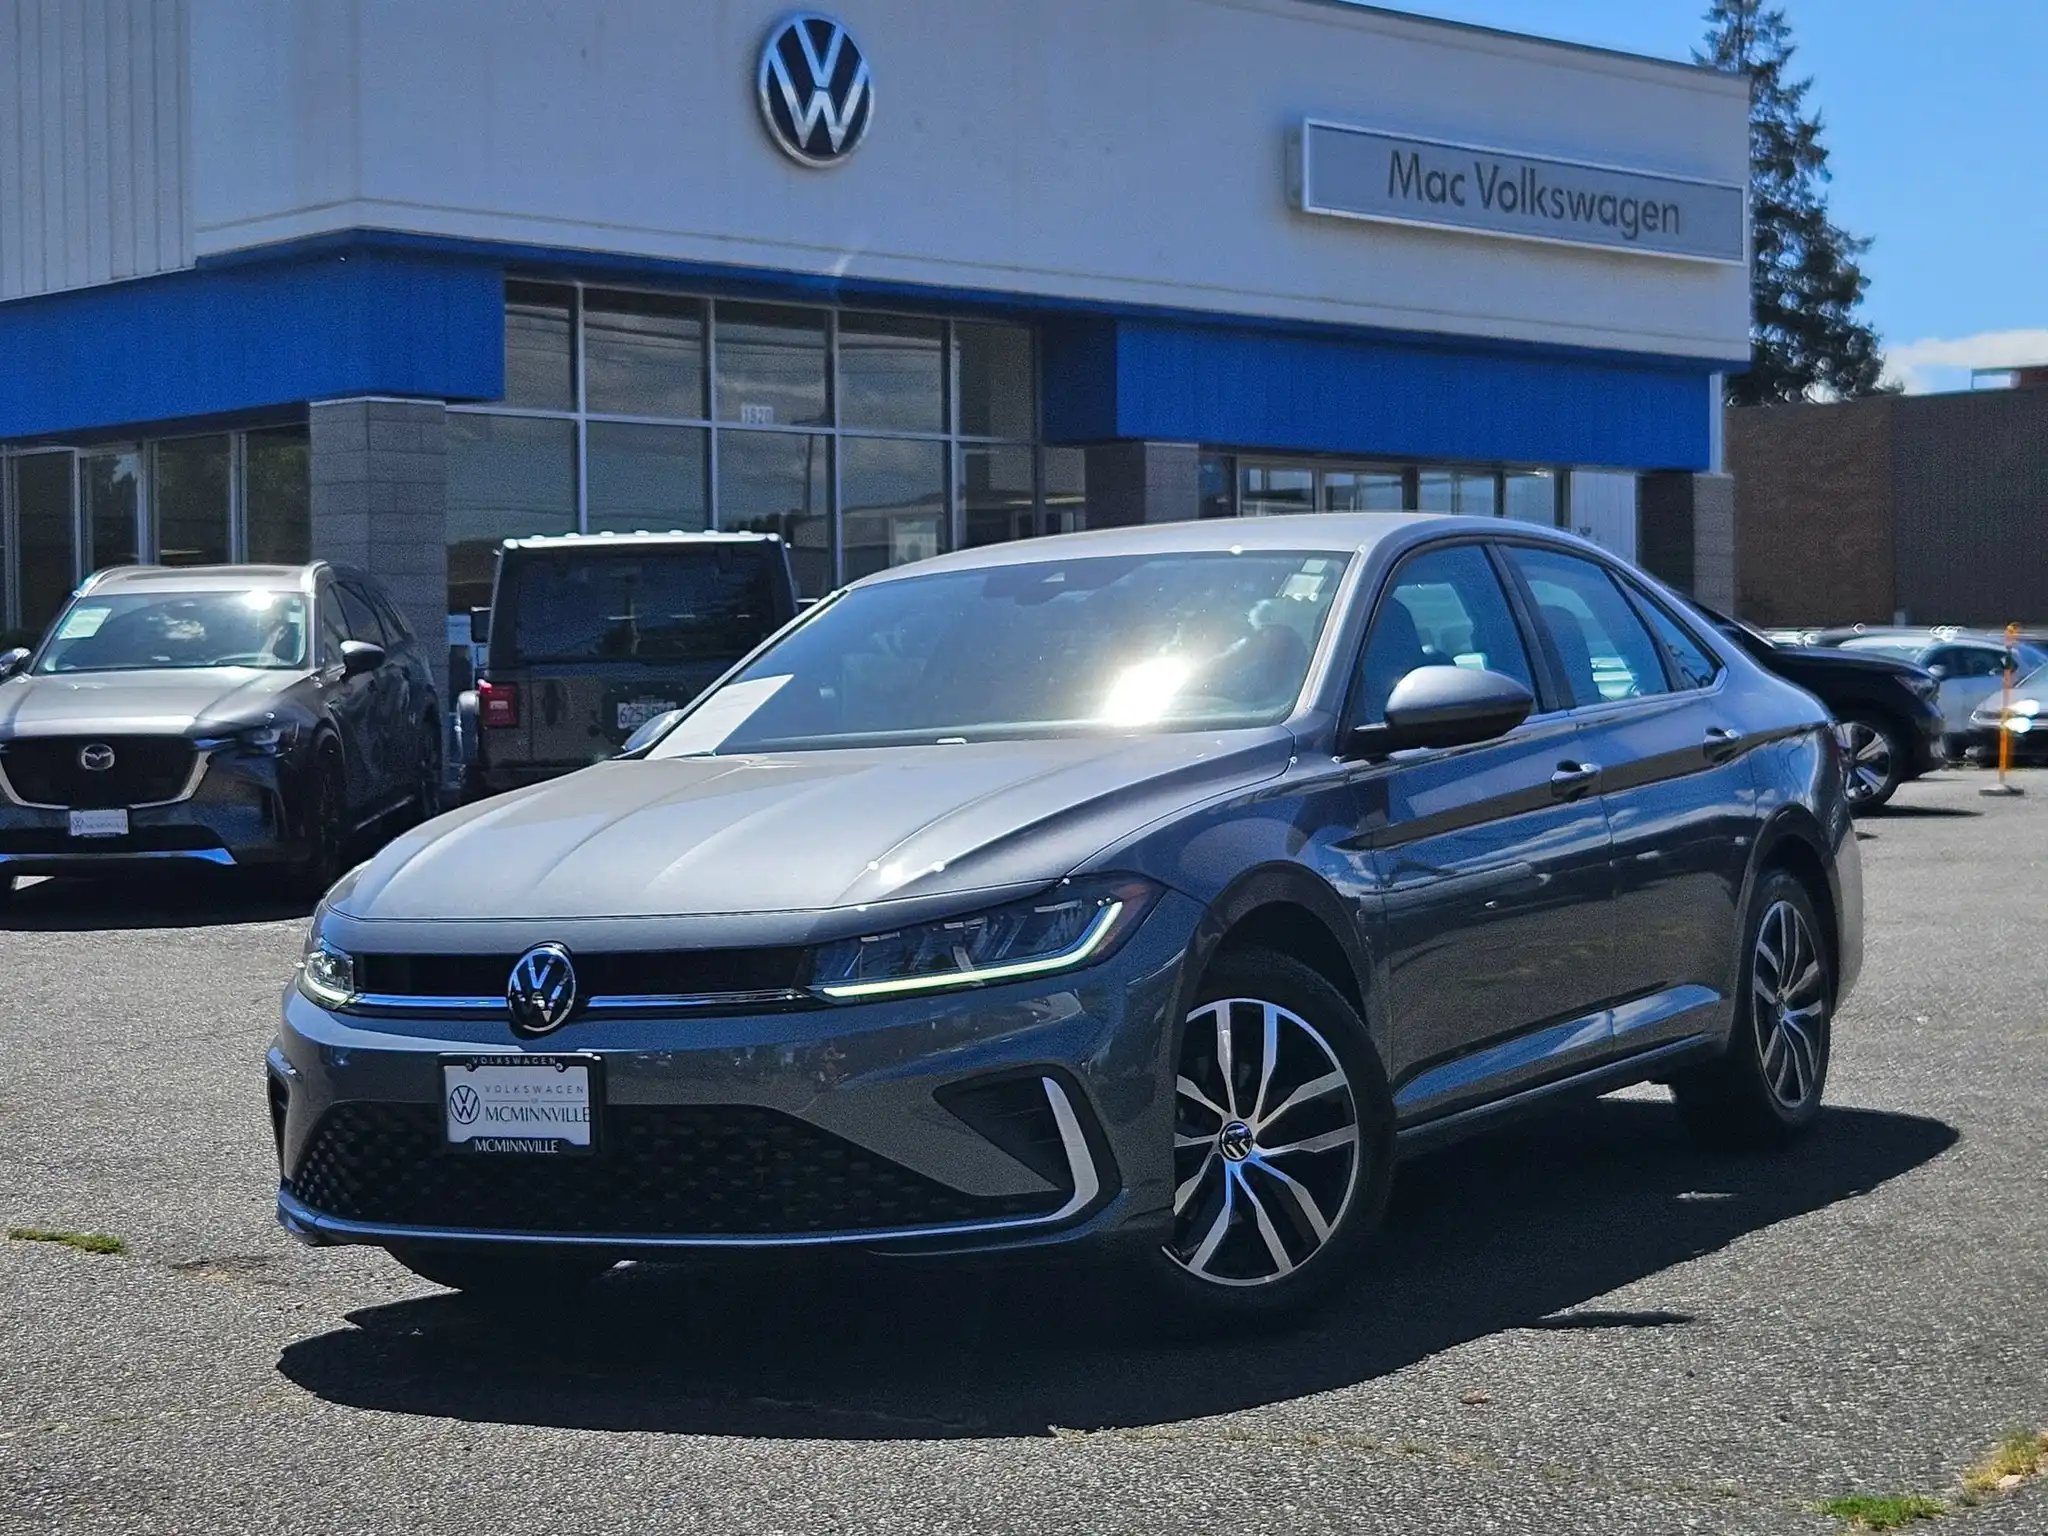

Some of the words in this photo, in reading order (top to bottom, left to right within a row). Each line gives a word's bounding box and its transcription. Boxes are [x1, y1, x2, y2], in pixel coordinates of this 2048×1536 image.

[767, 16, 869, 155] VW
[1387, 150, 1466, 207] Mac
[1473, 161, 1680, 241] Volkswagen
[471, 1056, 556, 1065] VOLKSWAGEN
[484, 1084, 585, 1095] VOLKSWAGEN
[451, 1086, 479, 1122] VW
[484, 1105, 591, 1123] MCMINNVILLE
[473, 1138, 560, 1153] MCMINNVILLE
